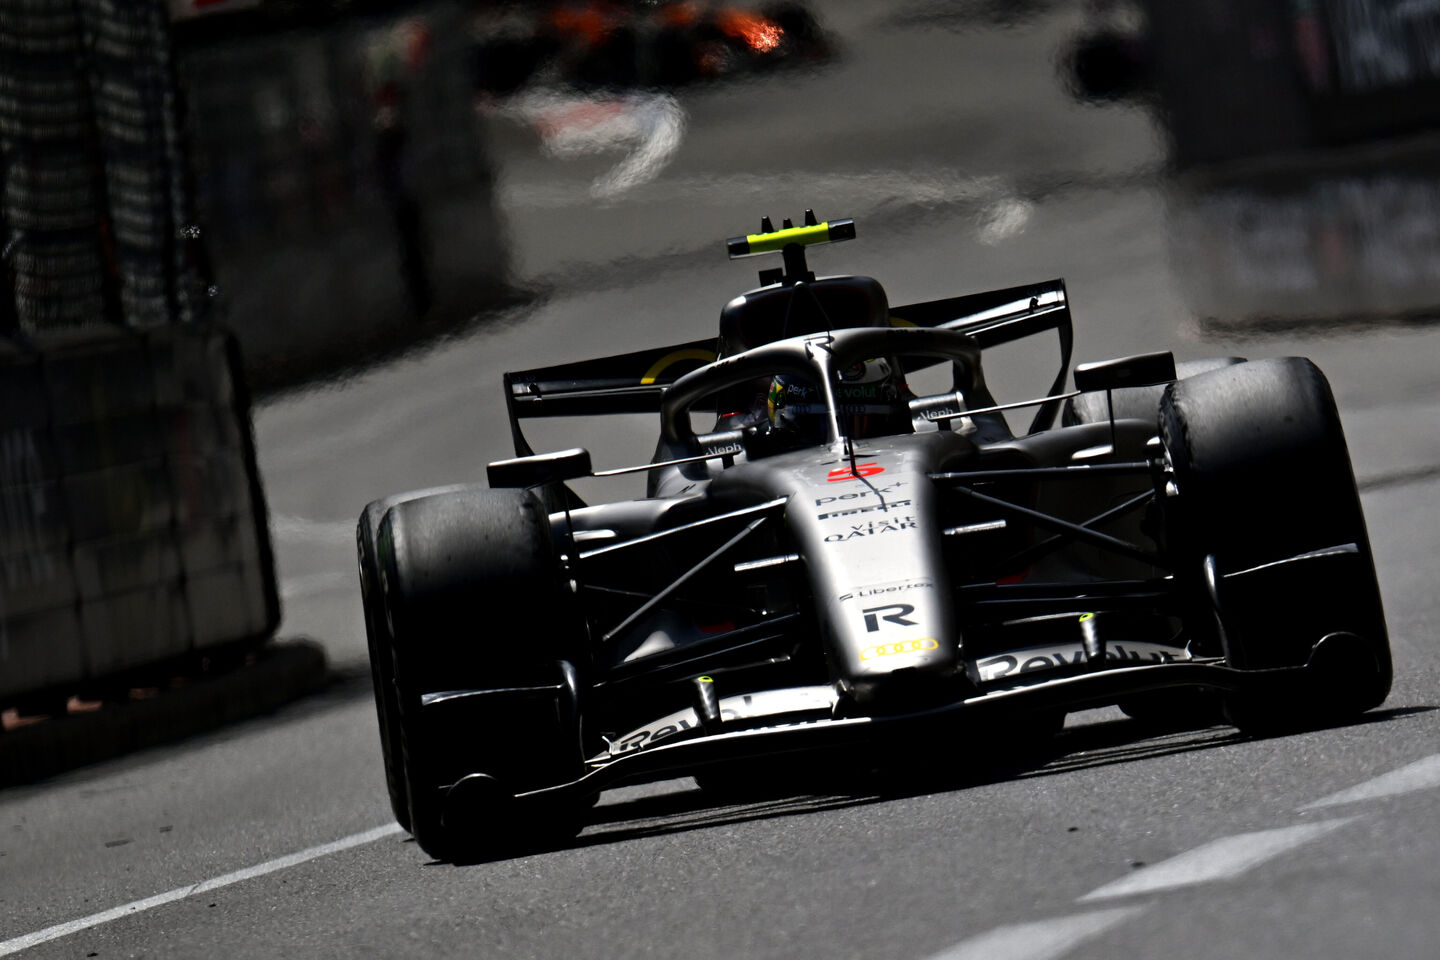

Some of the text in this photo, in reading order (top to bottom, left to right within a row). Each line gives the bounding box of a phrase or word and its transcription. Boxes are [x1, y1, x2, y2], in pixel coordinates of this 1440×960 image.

[827, 462, 885, 482] 5
[823, 522, 918, 543] QATAR
[862, 603, 919, 633] R
